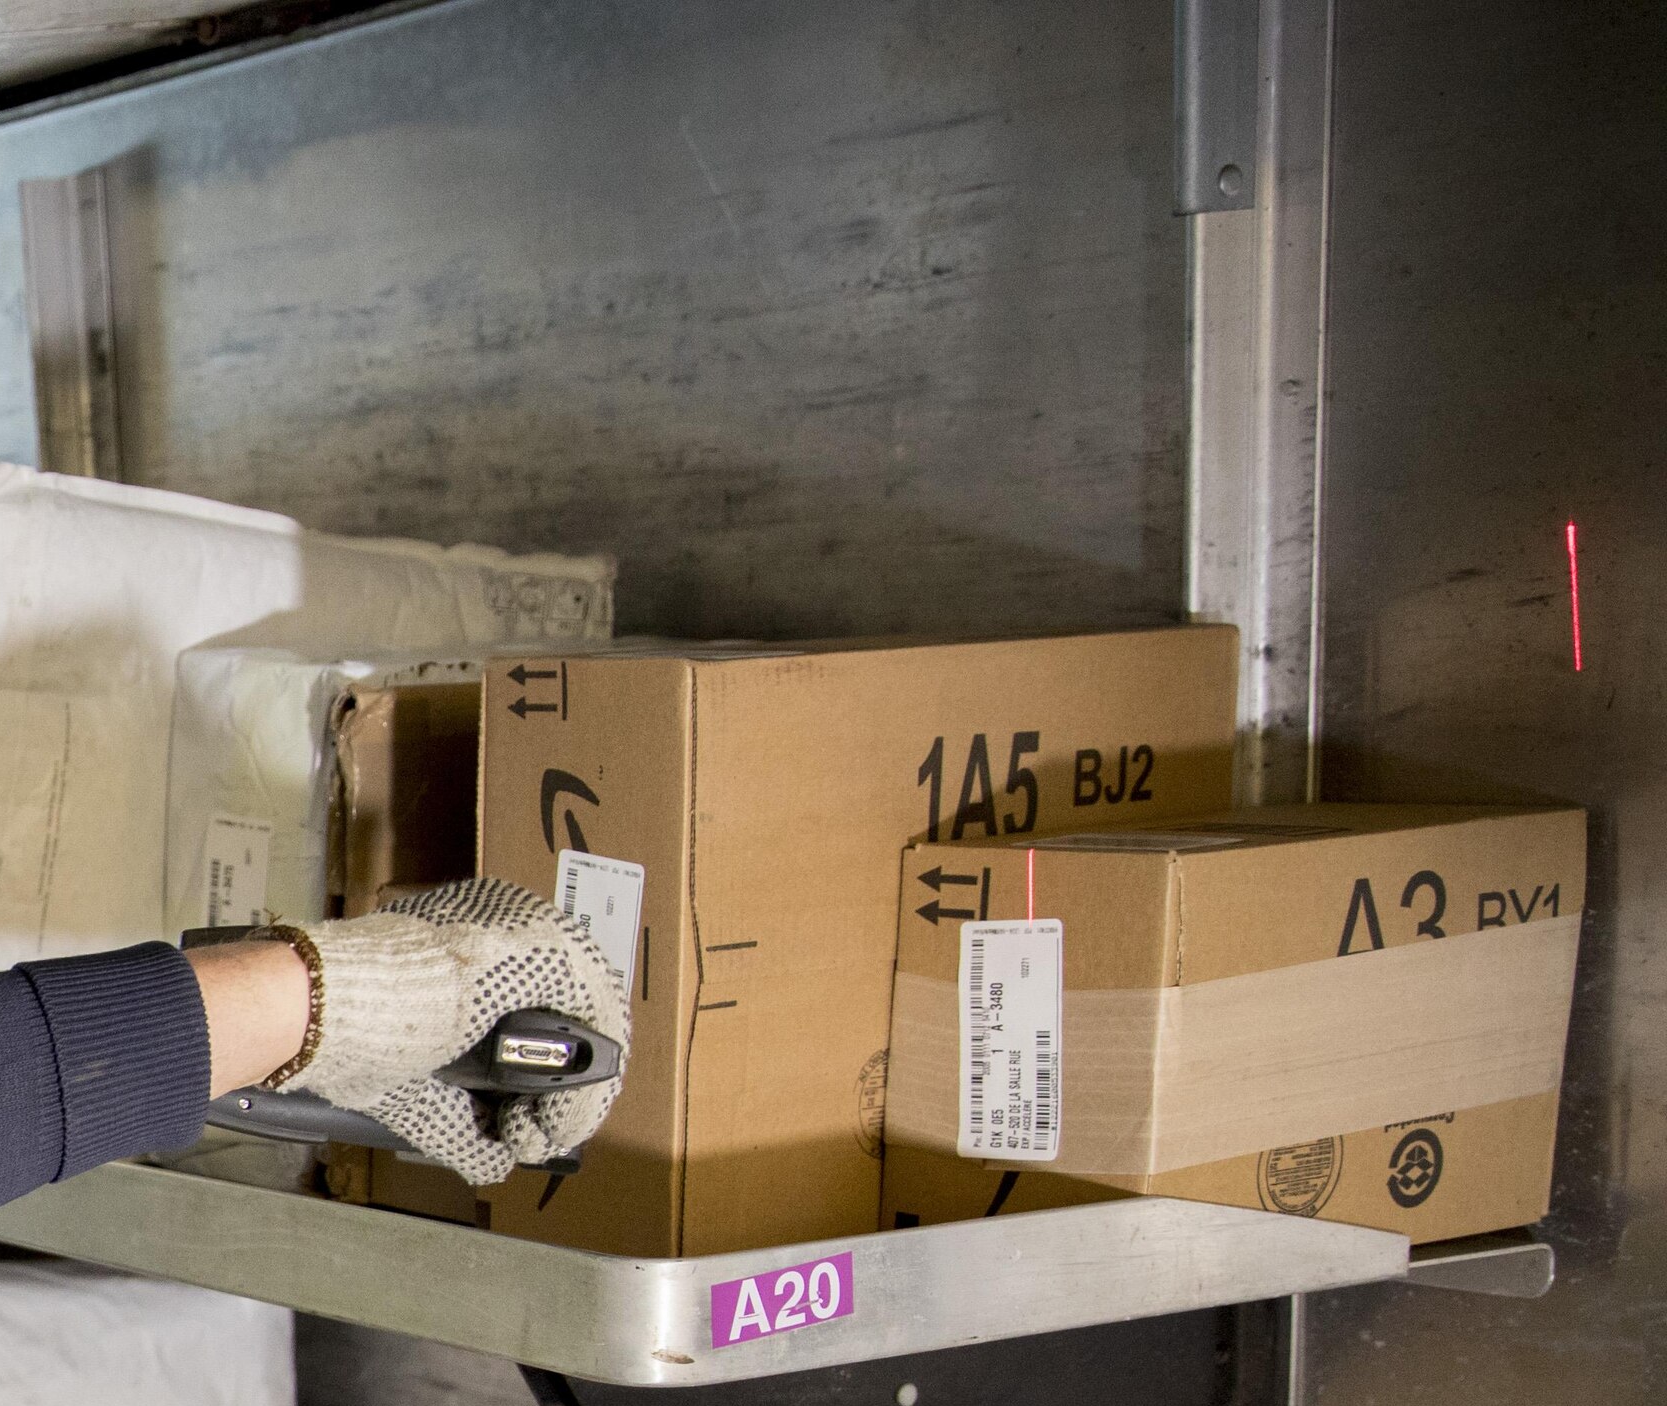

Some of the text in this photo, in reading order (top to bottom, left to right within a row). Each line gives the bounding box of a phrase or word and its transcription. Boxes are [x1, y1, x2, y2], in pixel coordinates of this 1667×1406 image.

[918, 731, 1154, 843] 1A5 BJ2
[1009, 1049, 1021, 1064] RUE
[1009, 1067, 1021, 1089] SALLE
[1008, 1091, 1020, 1101] LA
[1008, 1103, 1020, 1114] DE
[990, 1132, 1003, 1149] G1K
[1020, 1136, 1030, 1149] EXP
[728, 1261, 841, 1342] A20
